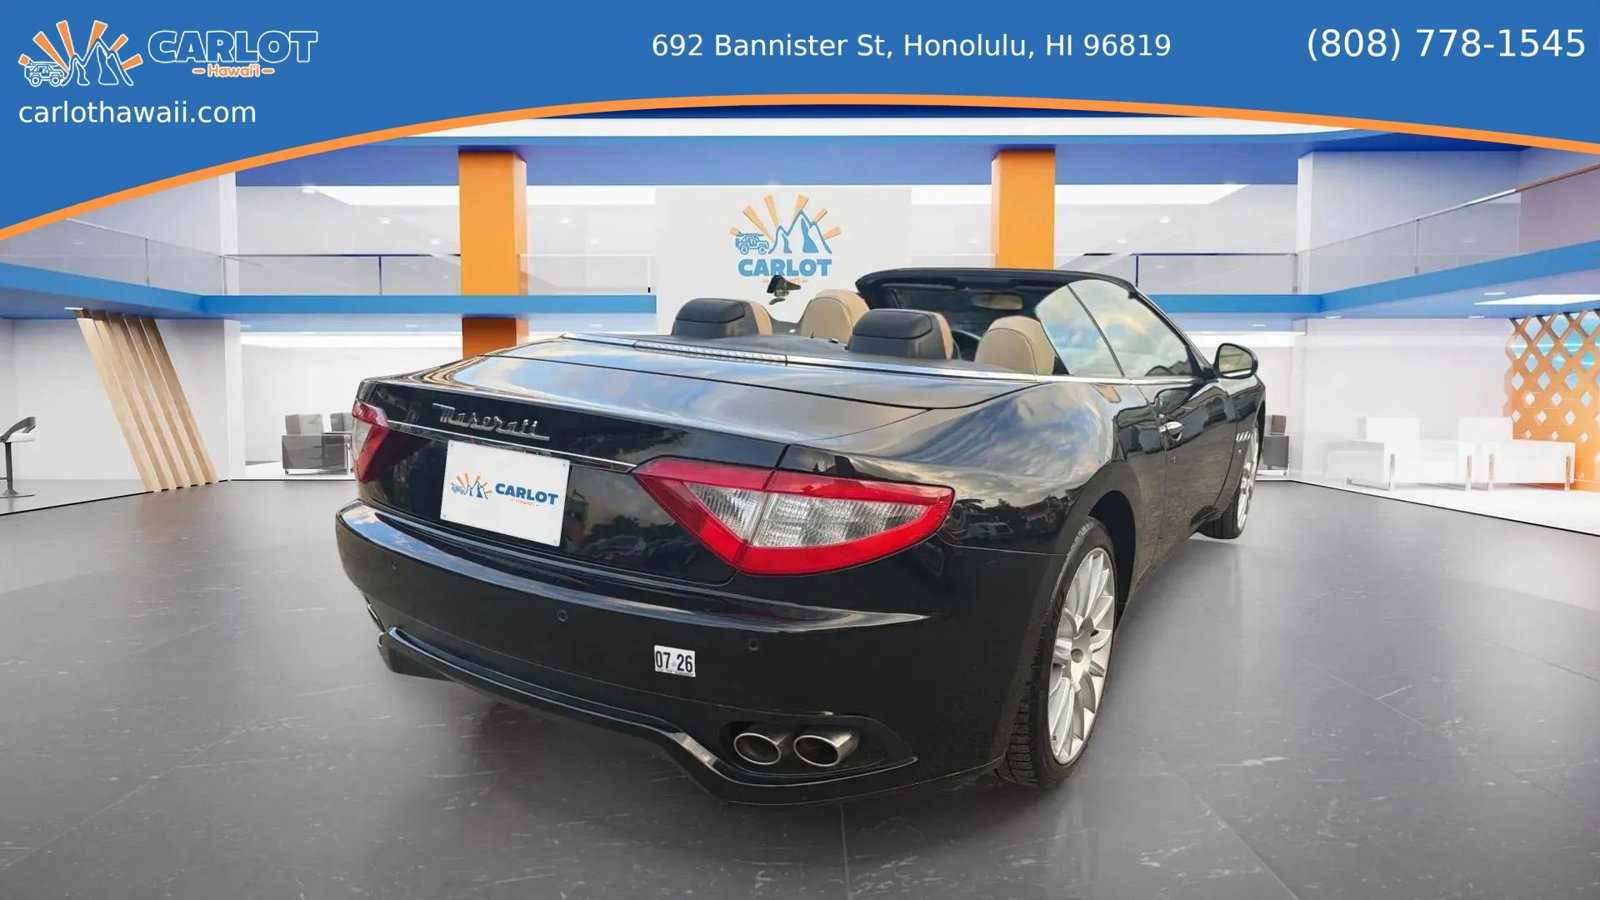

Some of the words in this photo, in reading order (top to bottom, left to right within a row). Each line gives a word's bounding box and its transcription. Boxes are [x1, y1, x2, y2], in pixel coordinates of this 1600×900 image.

[738, 258, 832, 277] CARLOT
[432, 402, 550, 441] Maserati
[495, 483, 558, 505] CARLOT
[655, 650, 671, 669] 07
[676, 653, 693, 673] 26
